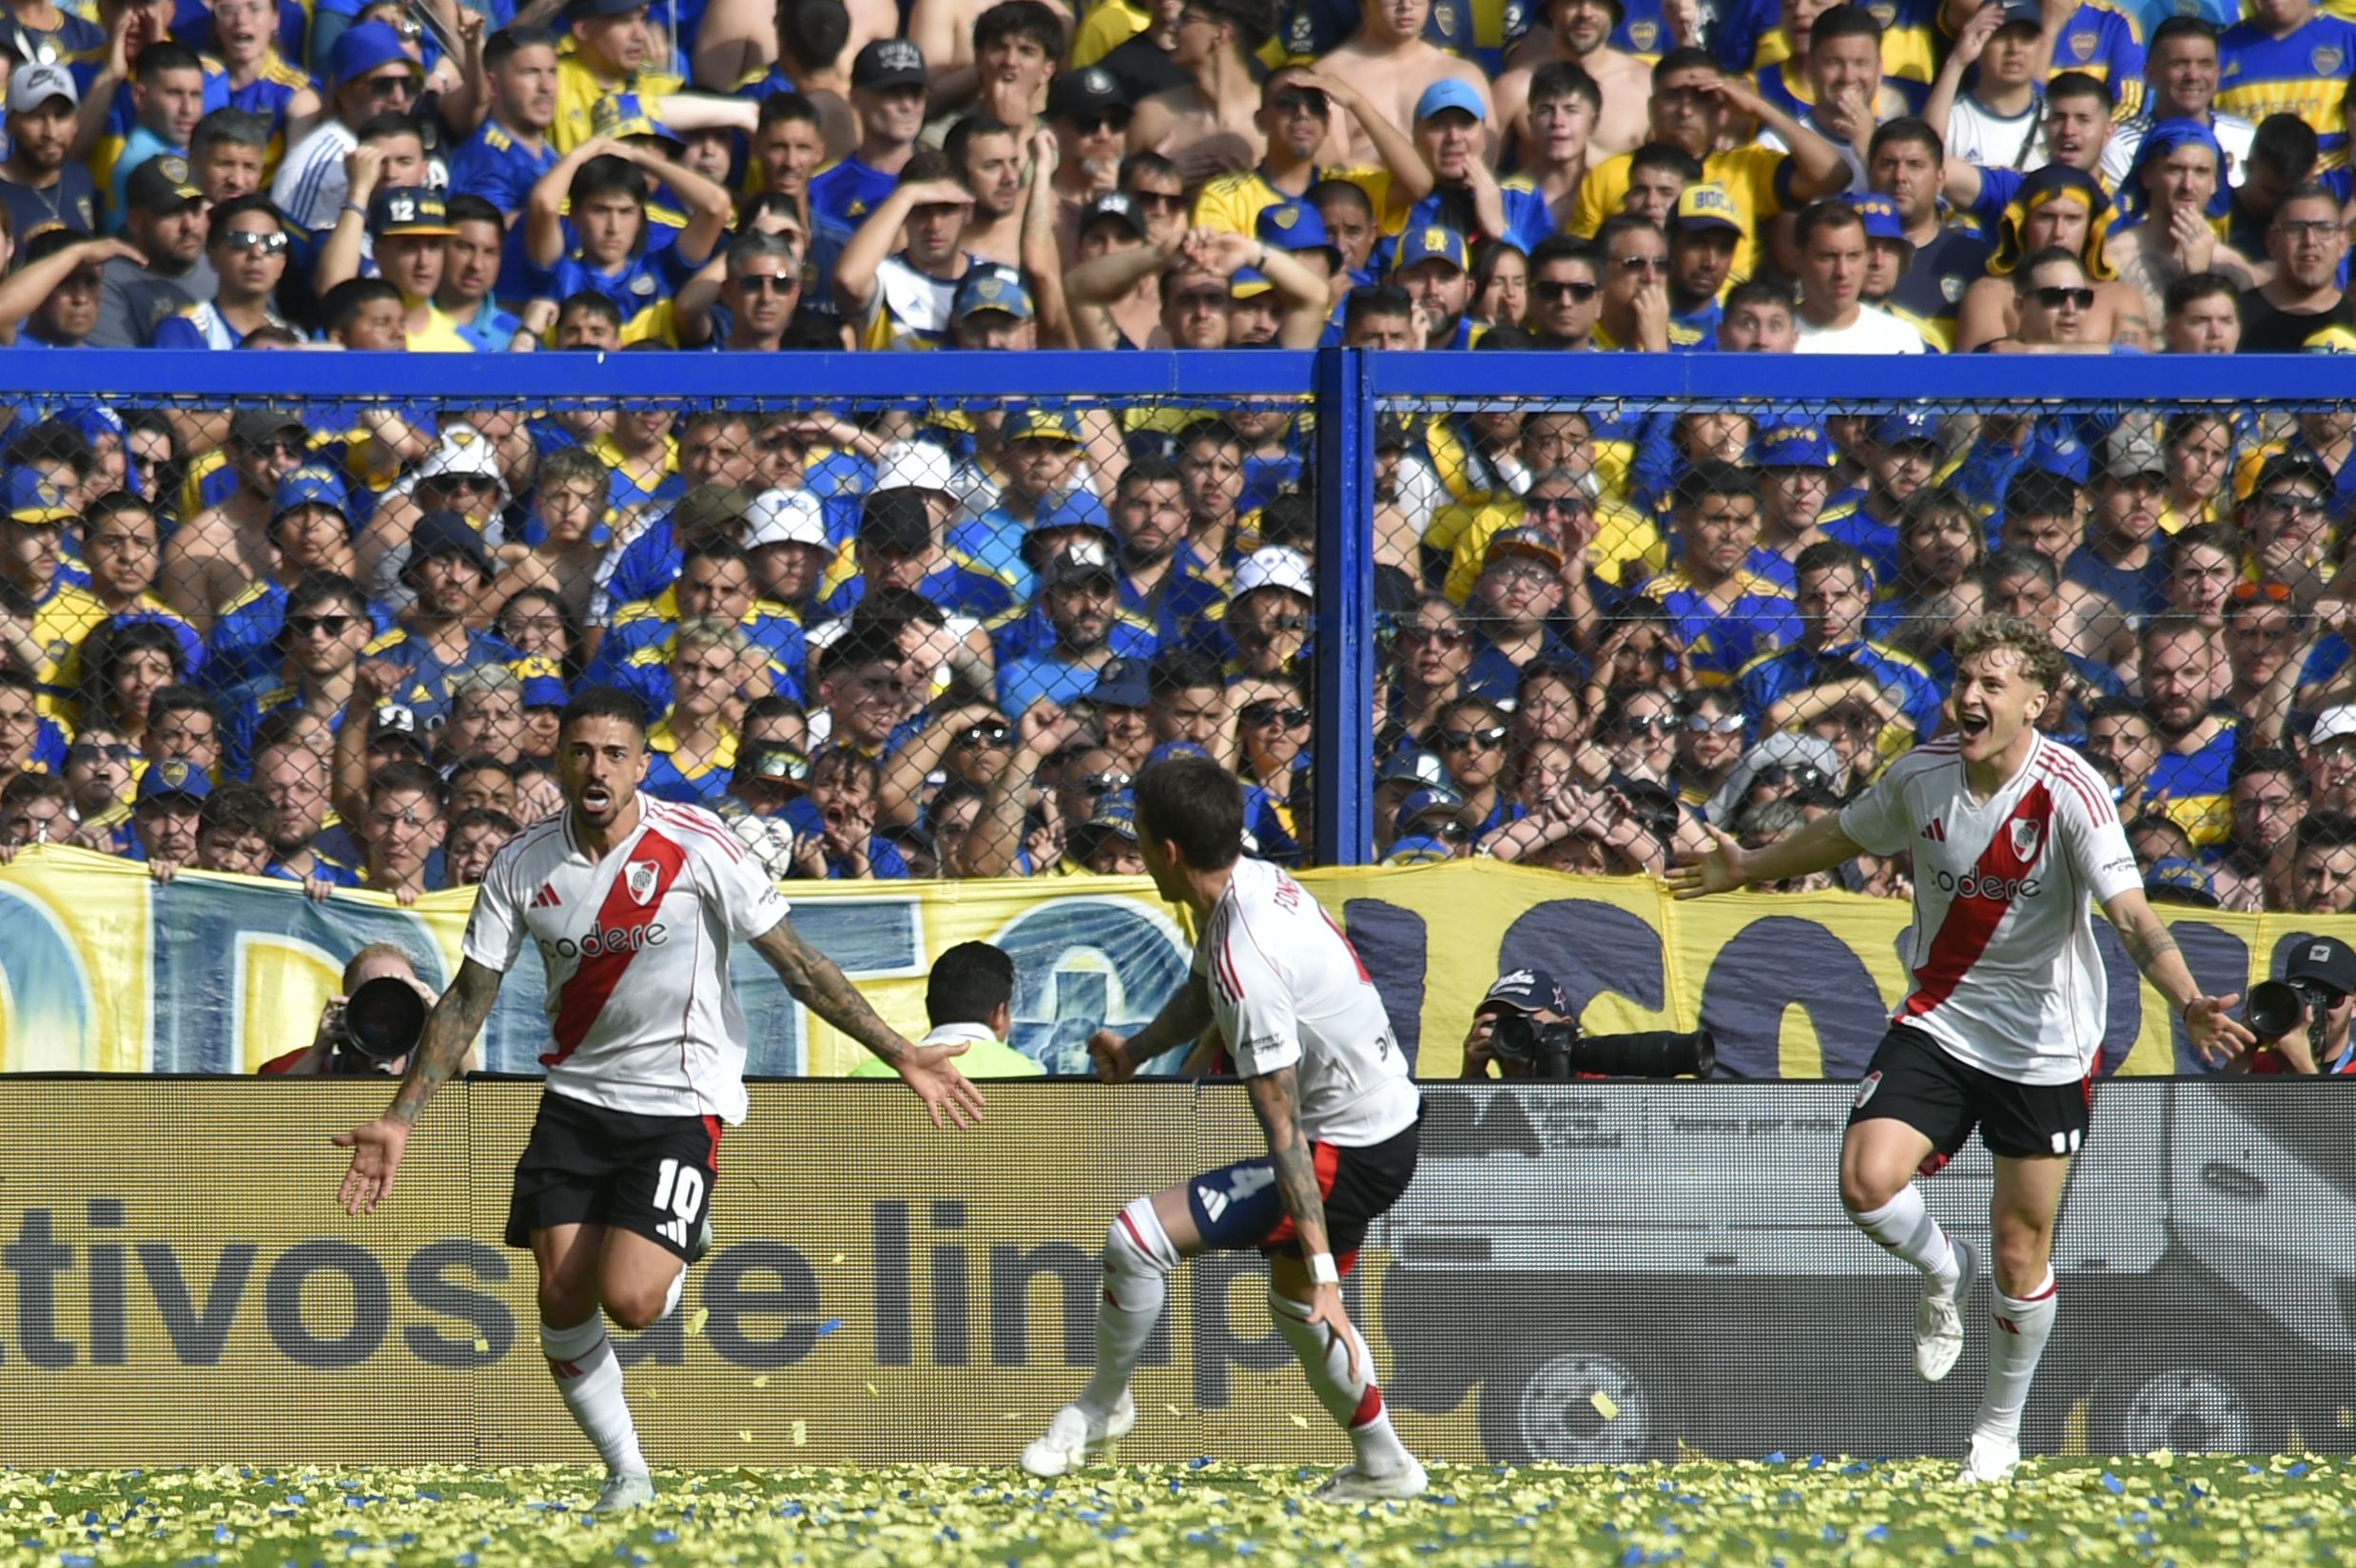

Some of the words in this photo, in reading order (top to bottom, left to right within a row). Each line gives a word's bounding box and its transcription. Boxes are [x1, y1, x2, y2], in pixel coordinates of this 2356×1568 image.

[390, 199, 415, 222] 12
[652, 1158, 704, 1225] 10
[0, 1200, 517, 1369] tivos
